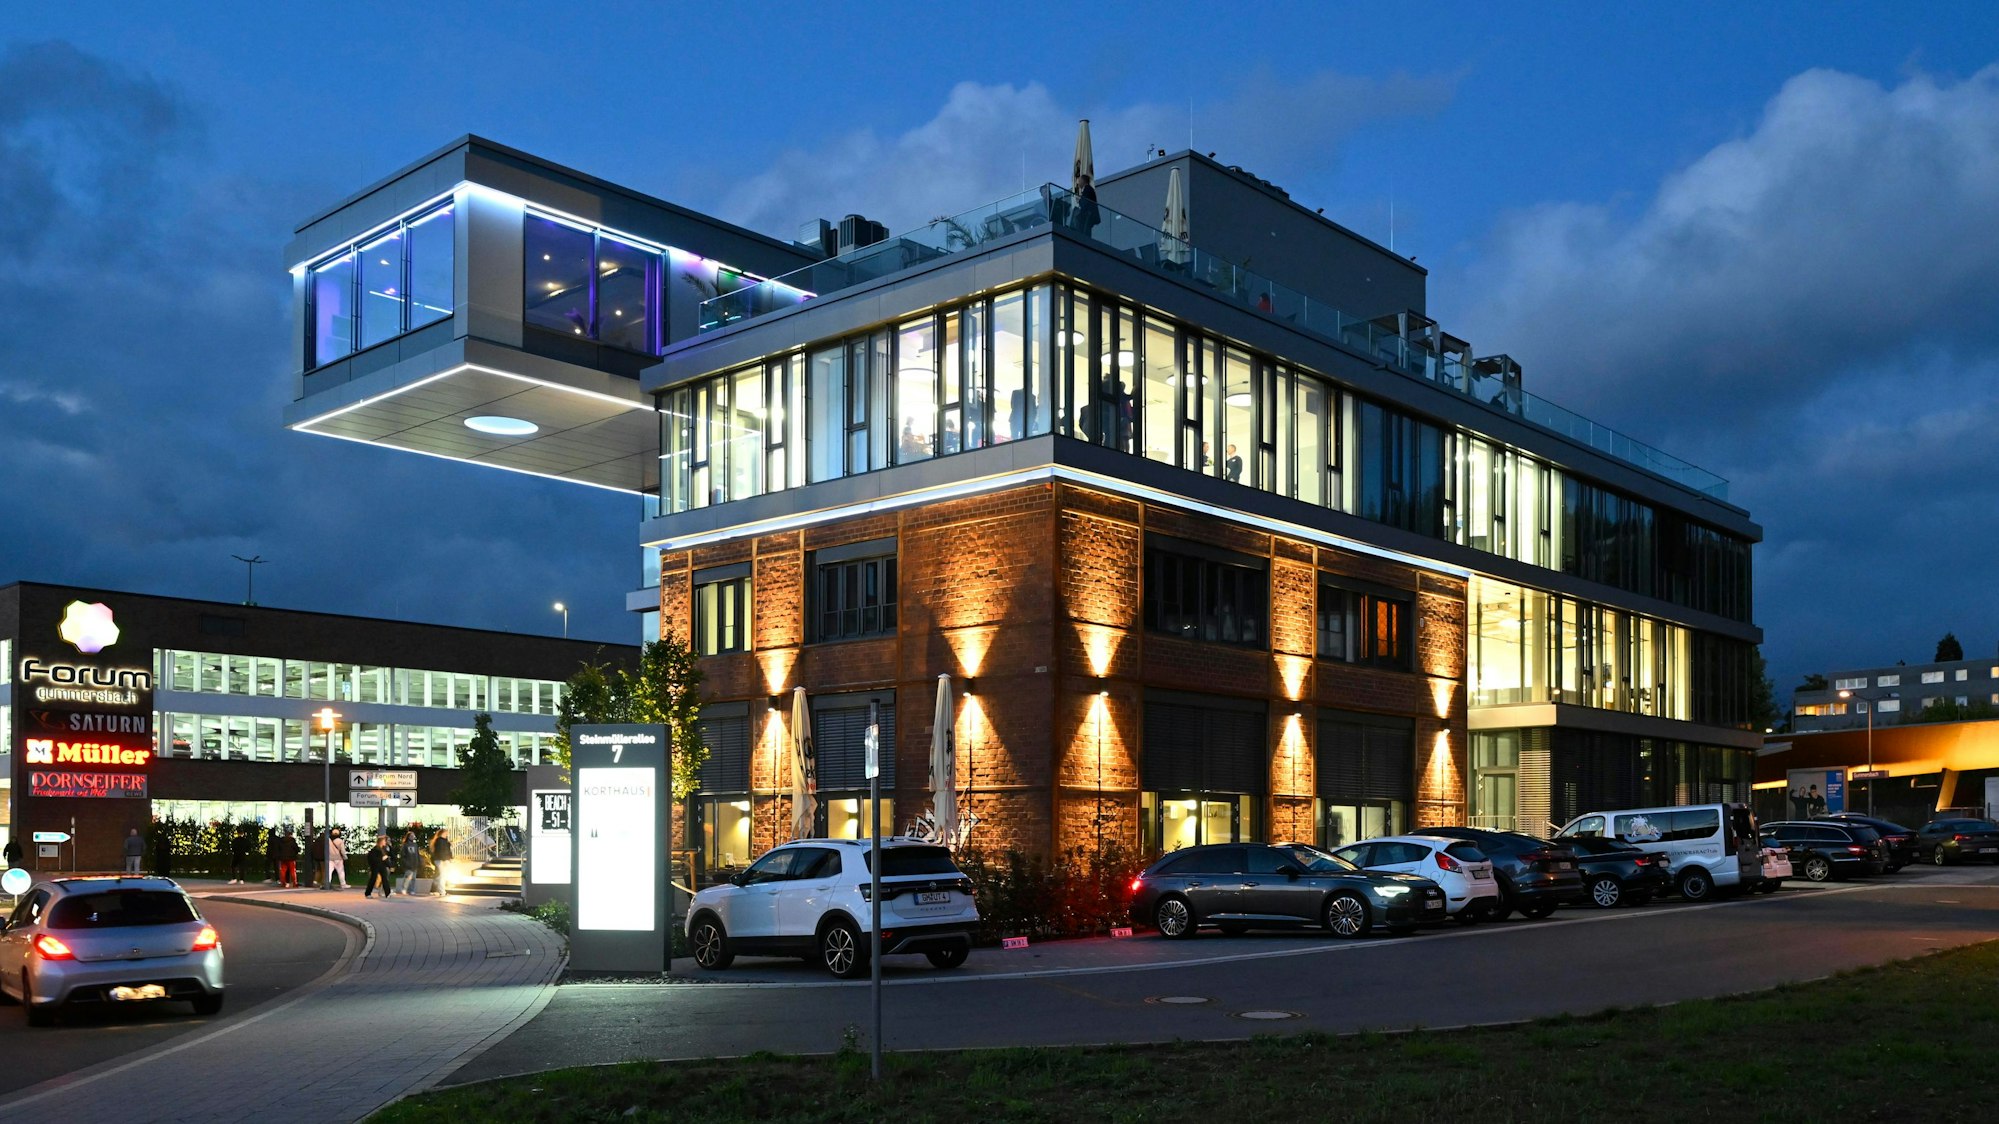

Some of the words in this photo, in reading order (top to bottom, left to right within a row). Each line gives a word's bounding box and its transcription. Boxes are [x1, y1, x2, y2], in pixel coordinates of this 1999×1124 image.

[23, 659, 151, 689] Forum
[36, 686, 138, 704] gummersbach
[69, 712, 146, 733] SATURN
[56, 741, 150, 766] Müller
[612, 745, 623, 763] 7
[584, 786, 646, 796] KORTHAUS
[544, 795, 567, 811] BEACH
